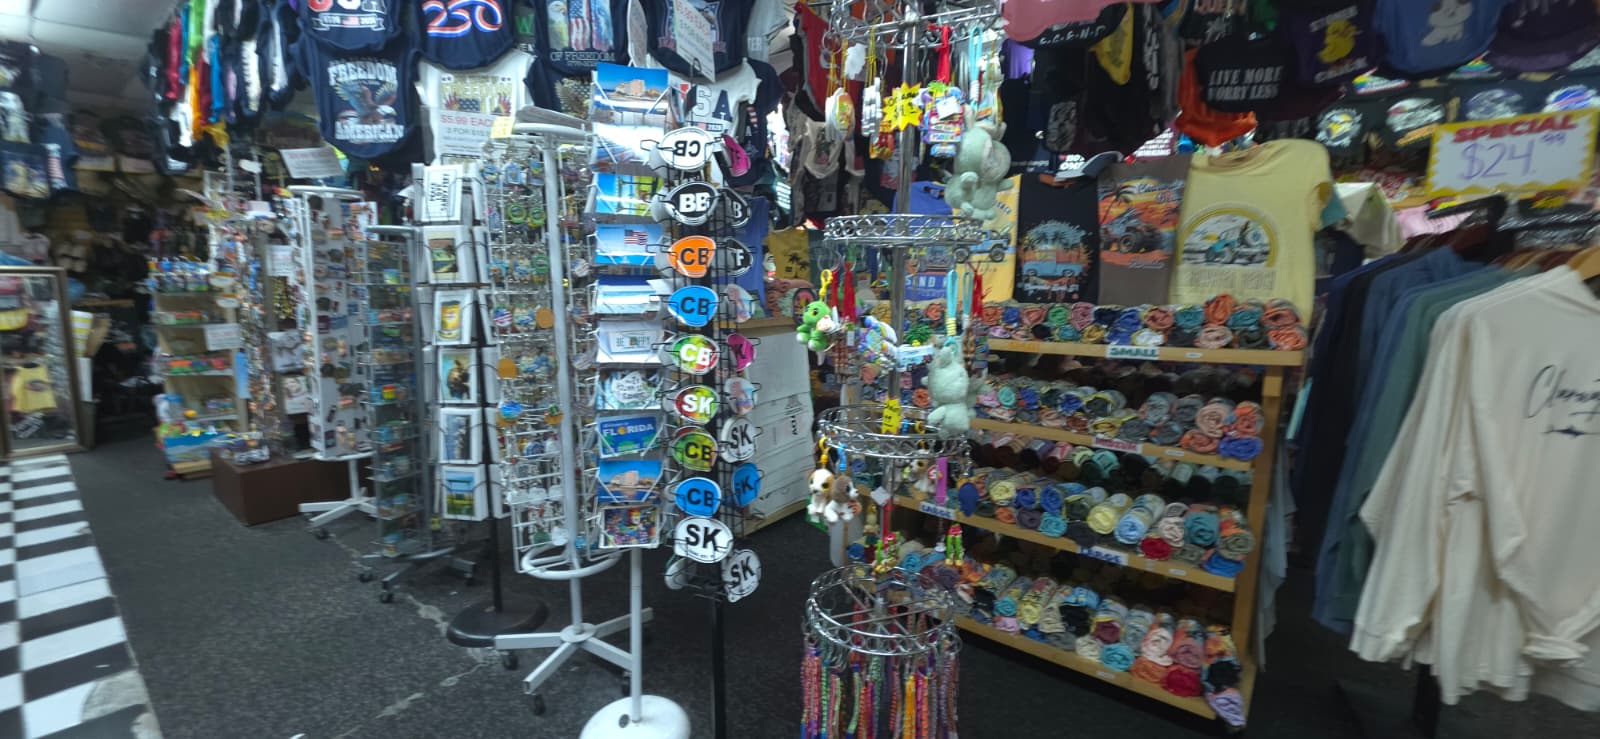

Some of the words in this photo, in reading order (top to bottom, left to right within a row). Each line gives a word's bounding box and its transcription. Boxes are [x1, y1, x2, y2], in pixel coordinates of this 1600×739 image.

[422, 0, 503, 37] 250
[328, 61, 397, 86] FREEDOM
[1209, 69, 1241, 86] LIVE
[1243, 65, 1284, 83] MORE
[1249, 83, 1280, 100] LESS
[335, 119, 404, 142] AMERICAN
[1454, 113, 1577, 143] SPECIAL
[679, 192, 710, 213] BB
[680, 247, 709, 265] CB
[680, 296, 709, 316] CB
[680, 343, 712, 366] CB
[1109, 346, 1157, 357] SMALL
[682, 393, 714, 415] SK
[602, 423, 654, 437] FLORIDA
[731, 423, 753, 449] SK
[684, 440, 713, 461] CB
[687, 487, 715, 508] CB
[686, 523, 723, 551] SK
[730, 557, 756, 589] SK
